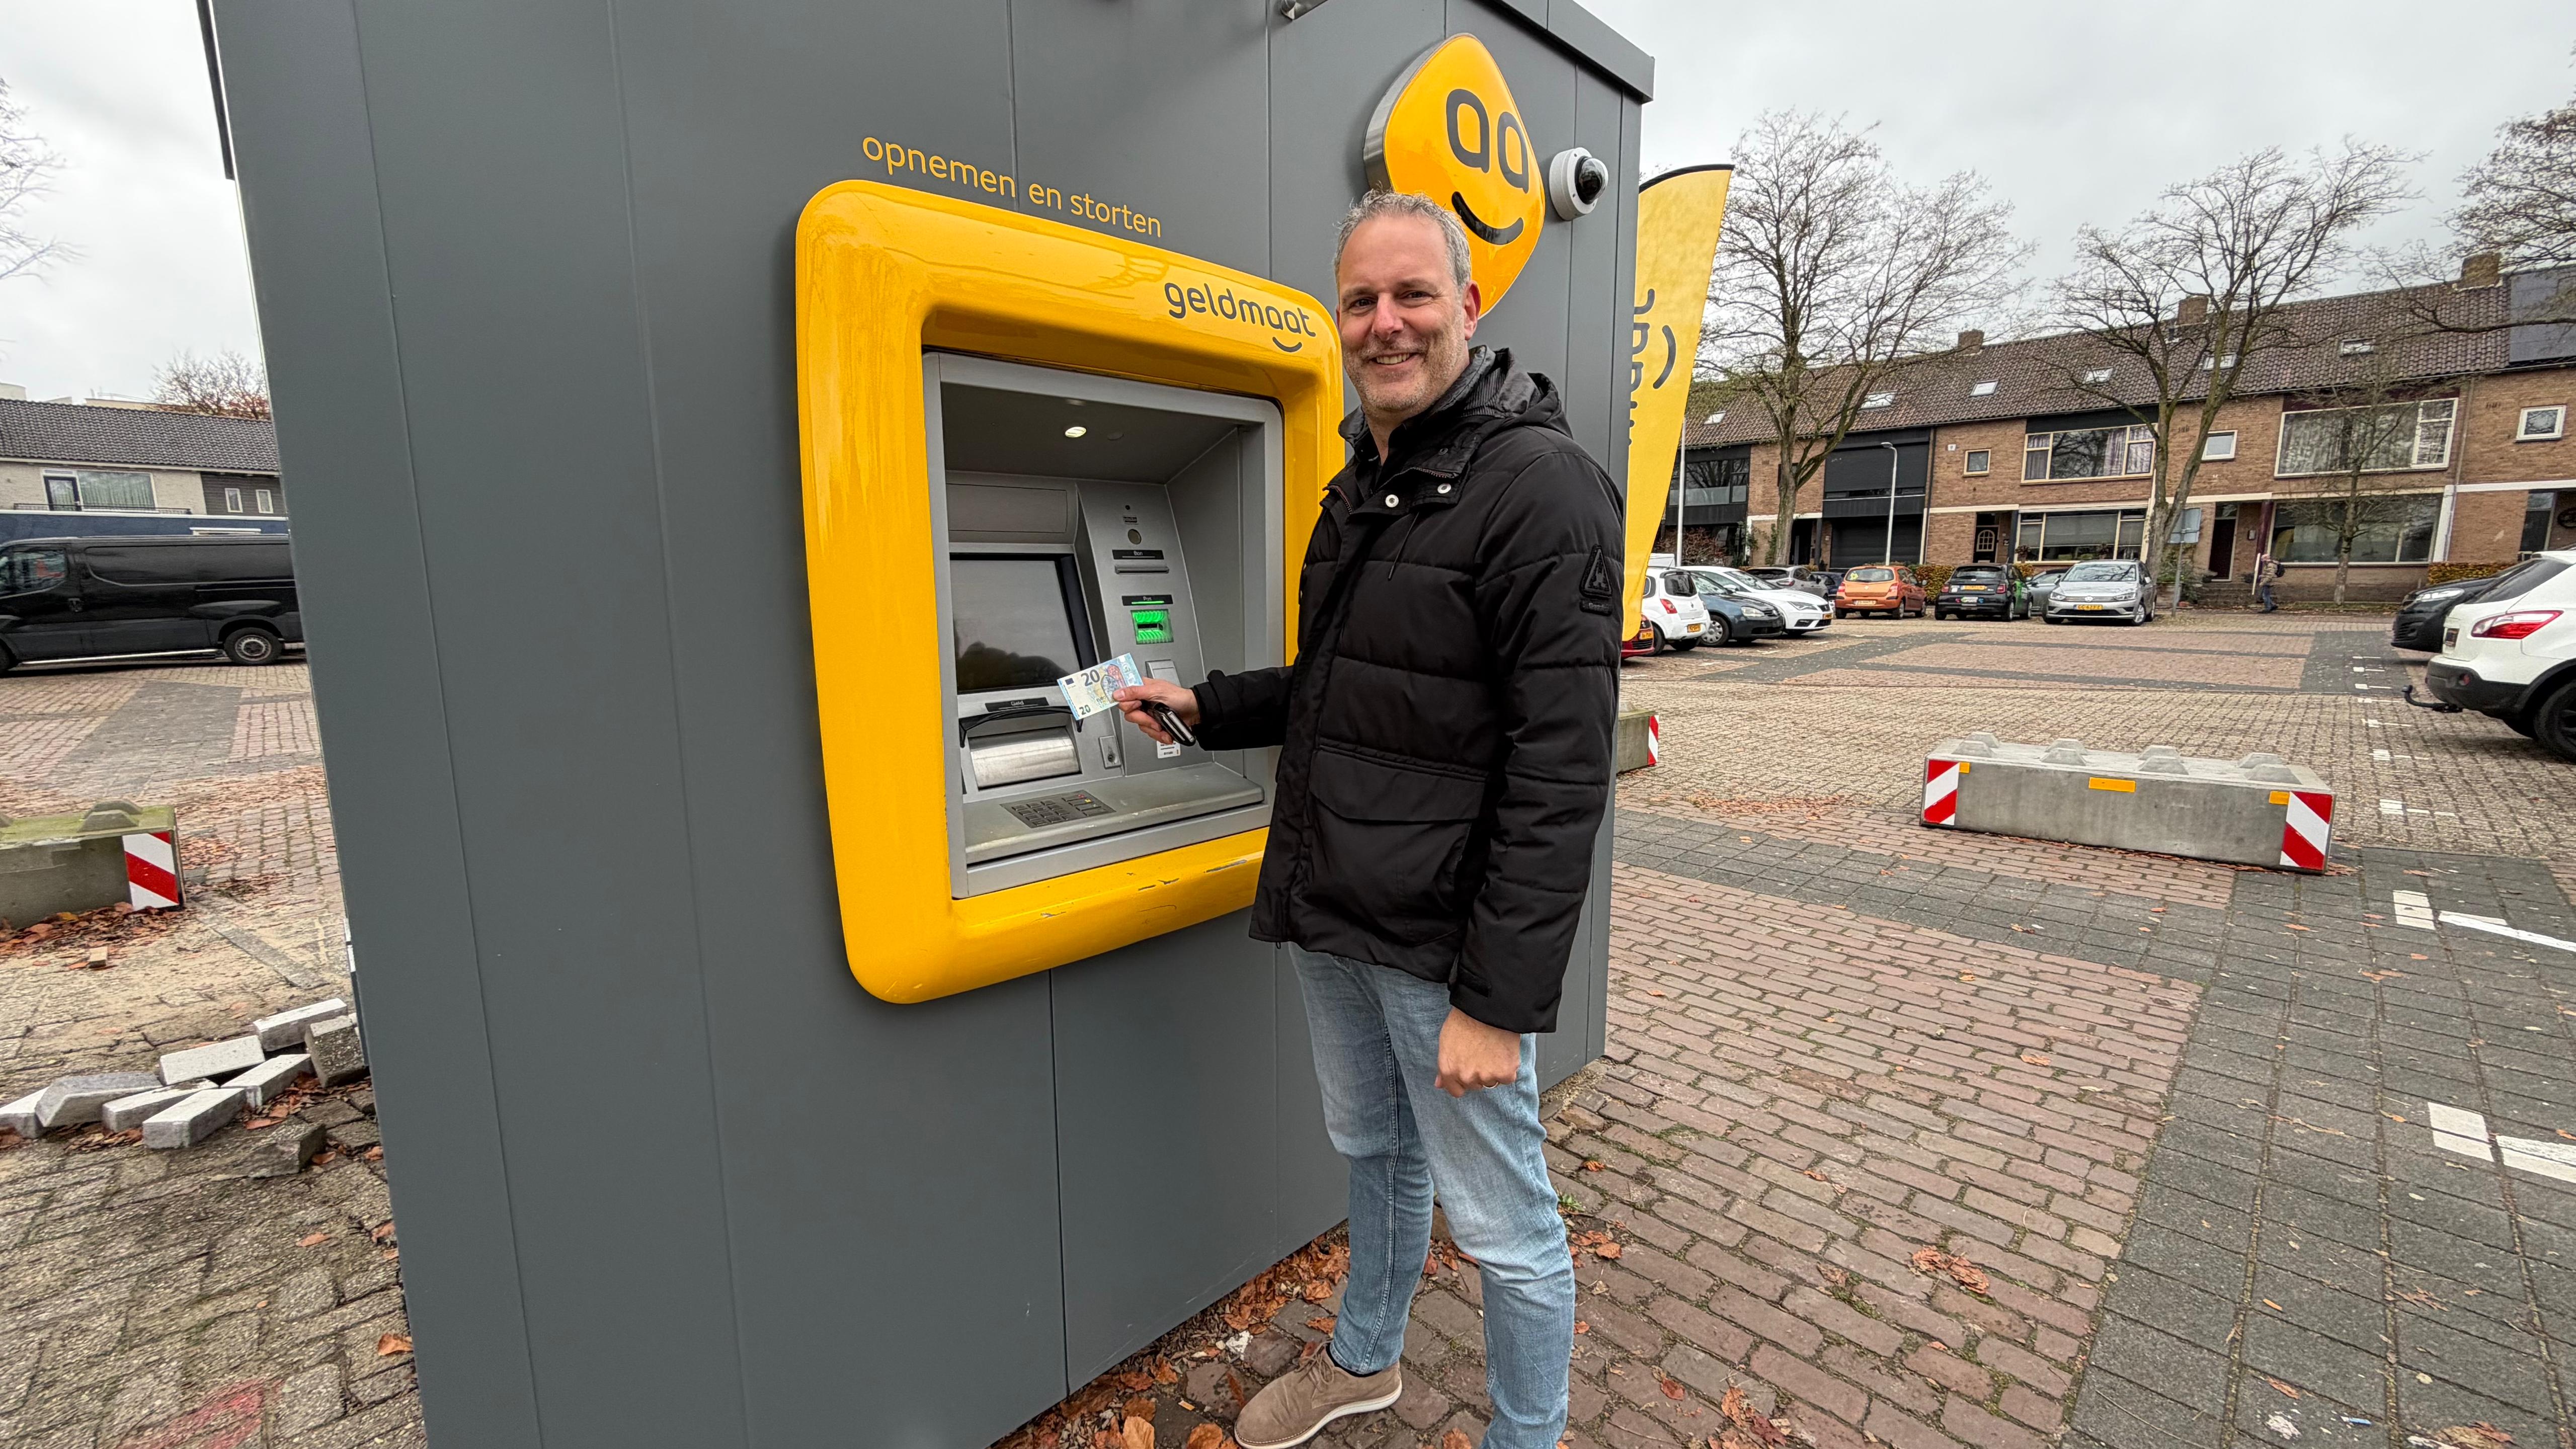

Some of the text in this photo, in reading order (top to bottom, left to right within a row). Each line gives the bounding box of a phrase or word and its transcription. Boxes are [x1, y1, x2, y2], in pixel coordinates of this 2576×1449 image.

[862, 136, 1162, 237] opnemen en storten
[1164, 282, 1316, 337] geldmaat
[1081, 669, 1100, 687] 20
[1079, 704, 1091, 715] 20
